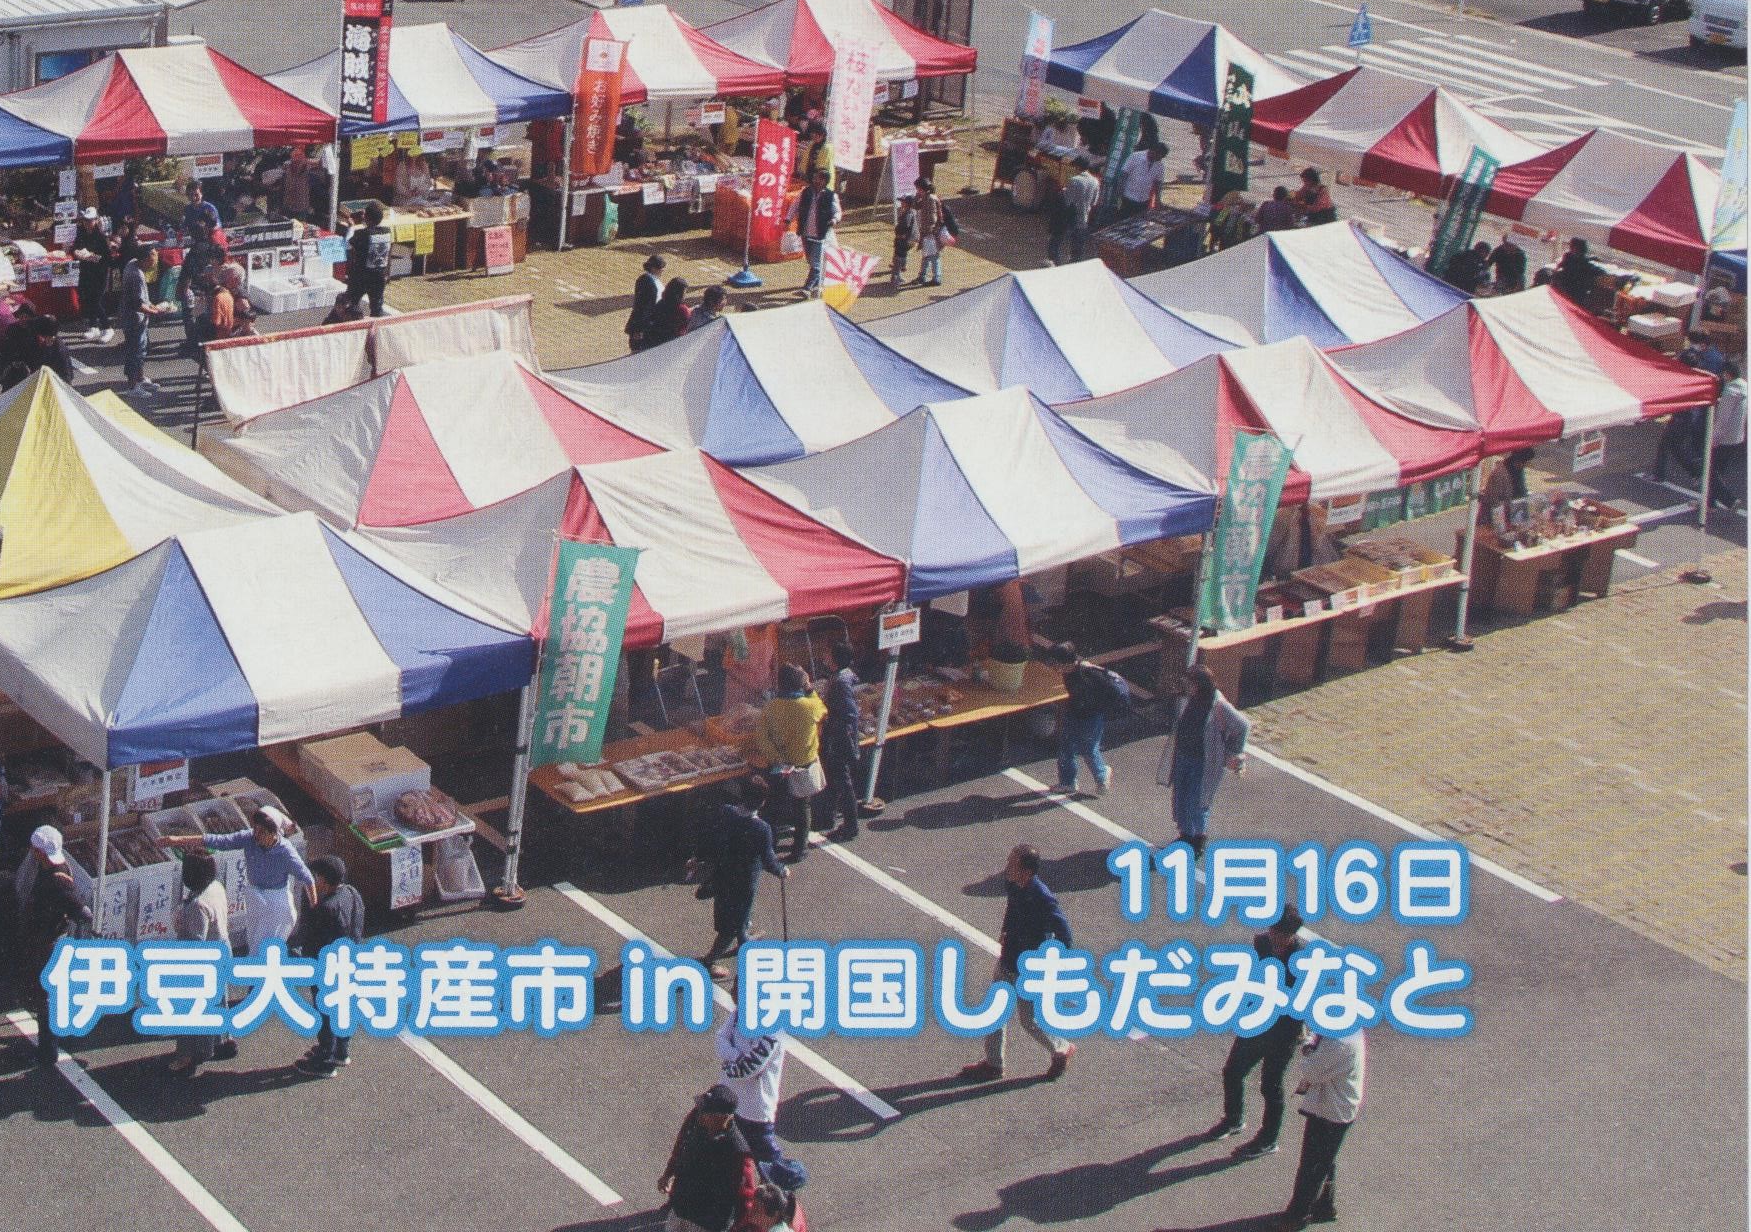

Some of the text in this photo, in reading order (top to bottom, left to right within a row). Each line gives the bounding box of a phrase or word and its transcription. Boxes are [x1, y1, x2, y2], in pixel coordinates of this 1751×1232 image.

[343, 23, 372, 107] 海賊焼
[586, 79, 608, 155] お好み焼き
[543, 557, 621, 750] 農協朝市
